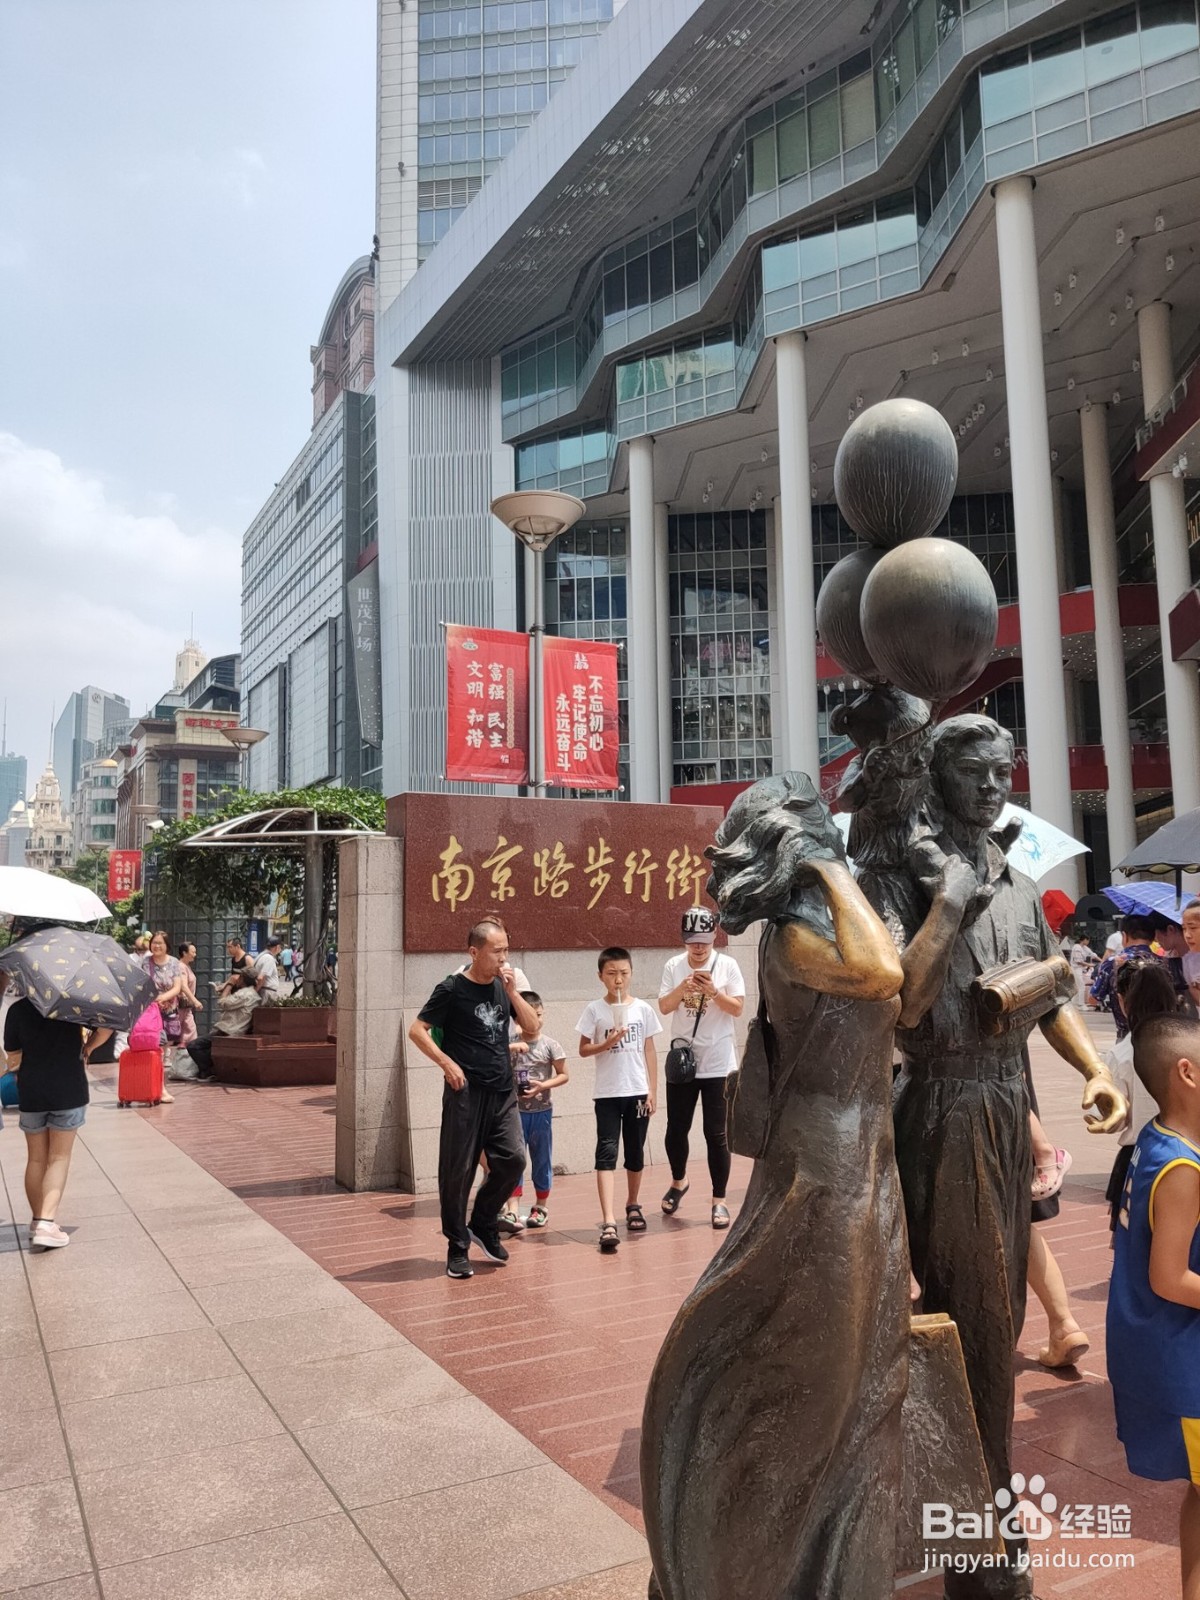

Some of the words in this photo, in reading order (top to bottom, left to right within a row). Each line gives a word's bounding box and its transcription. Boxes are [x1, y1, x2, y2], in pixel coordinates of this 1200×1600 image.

[357, 588, 372, 652] 世茂广场
[467, 661, 484, 699] 文明
[488, 662, 505, 700] 富强
[466, 708, 484, 748] 和谐
[488, 712, 505, 748] 民主
[556, 693, 571, 772] 永远奋斗
[573, 684, 587, 762] 牢记使命
[589, 675, 604, 752] 不忘初心
[432, 834, 707, 912] 南京路步行街
[686, 1009, 707, 1018] 209
